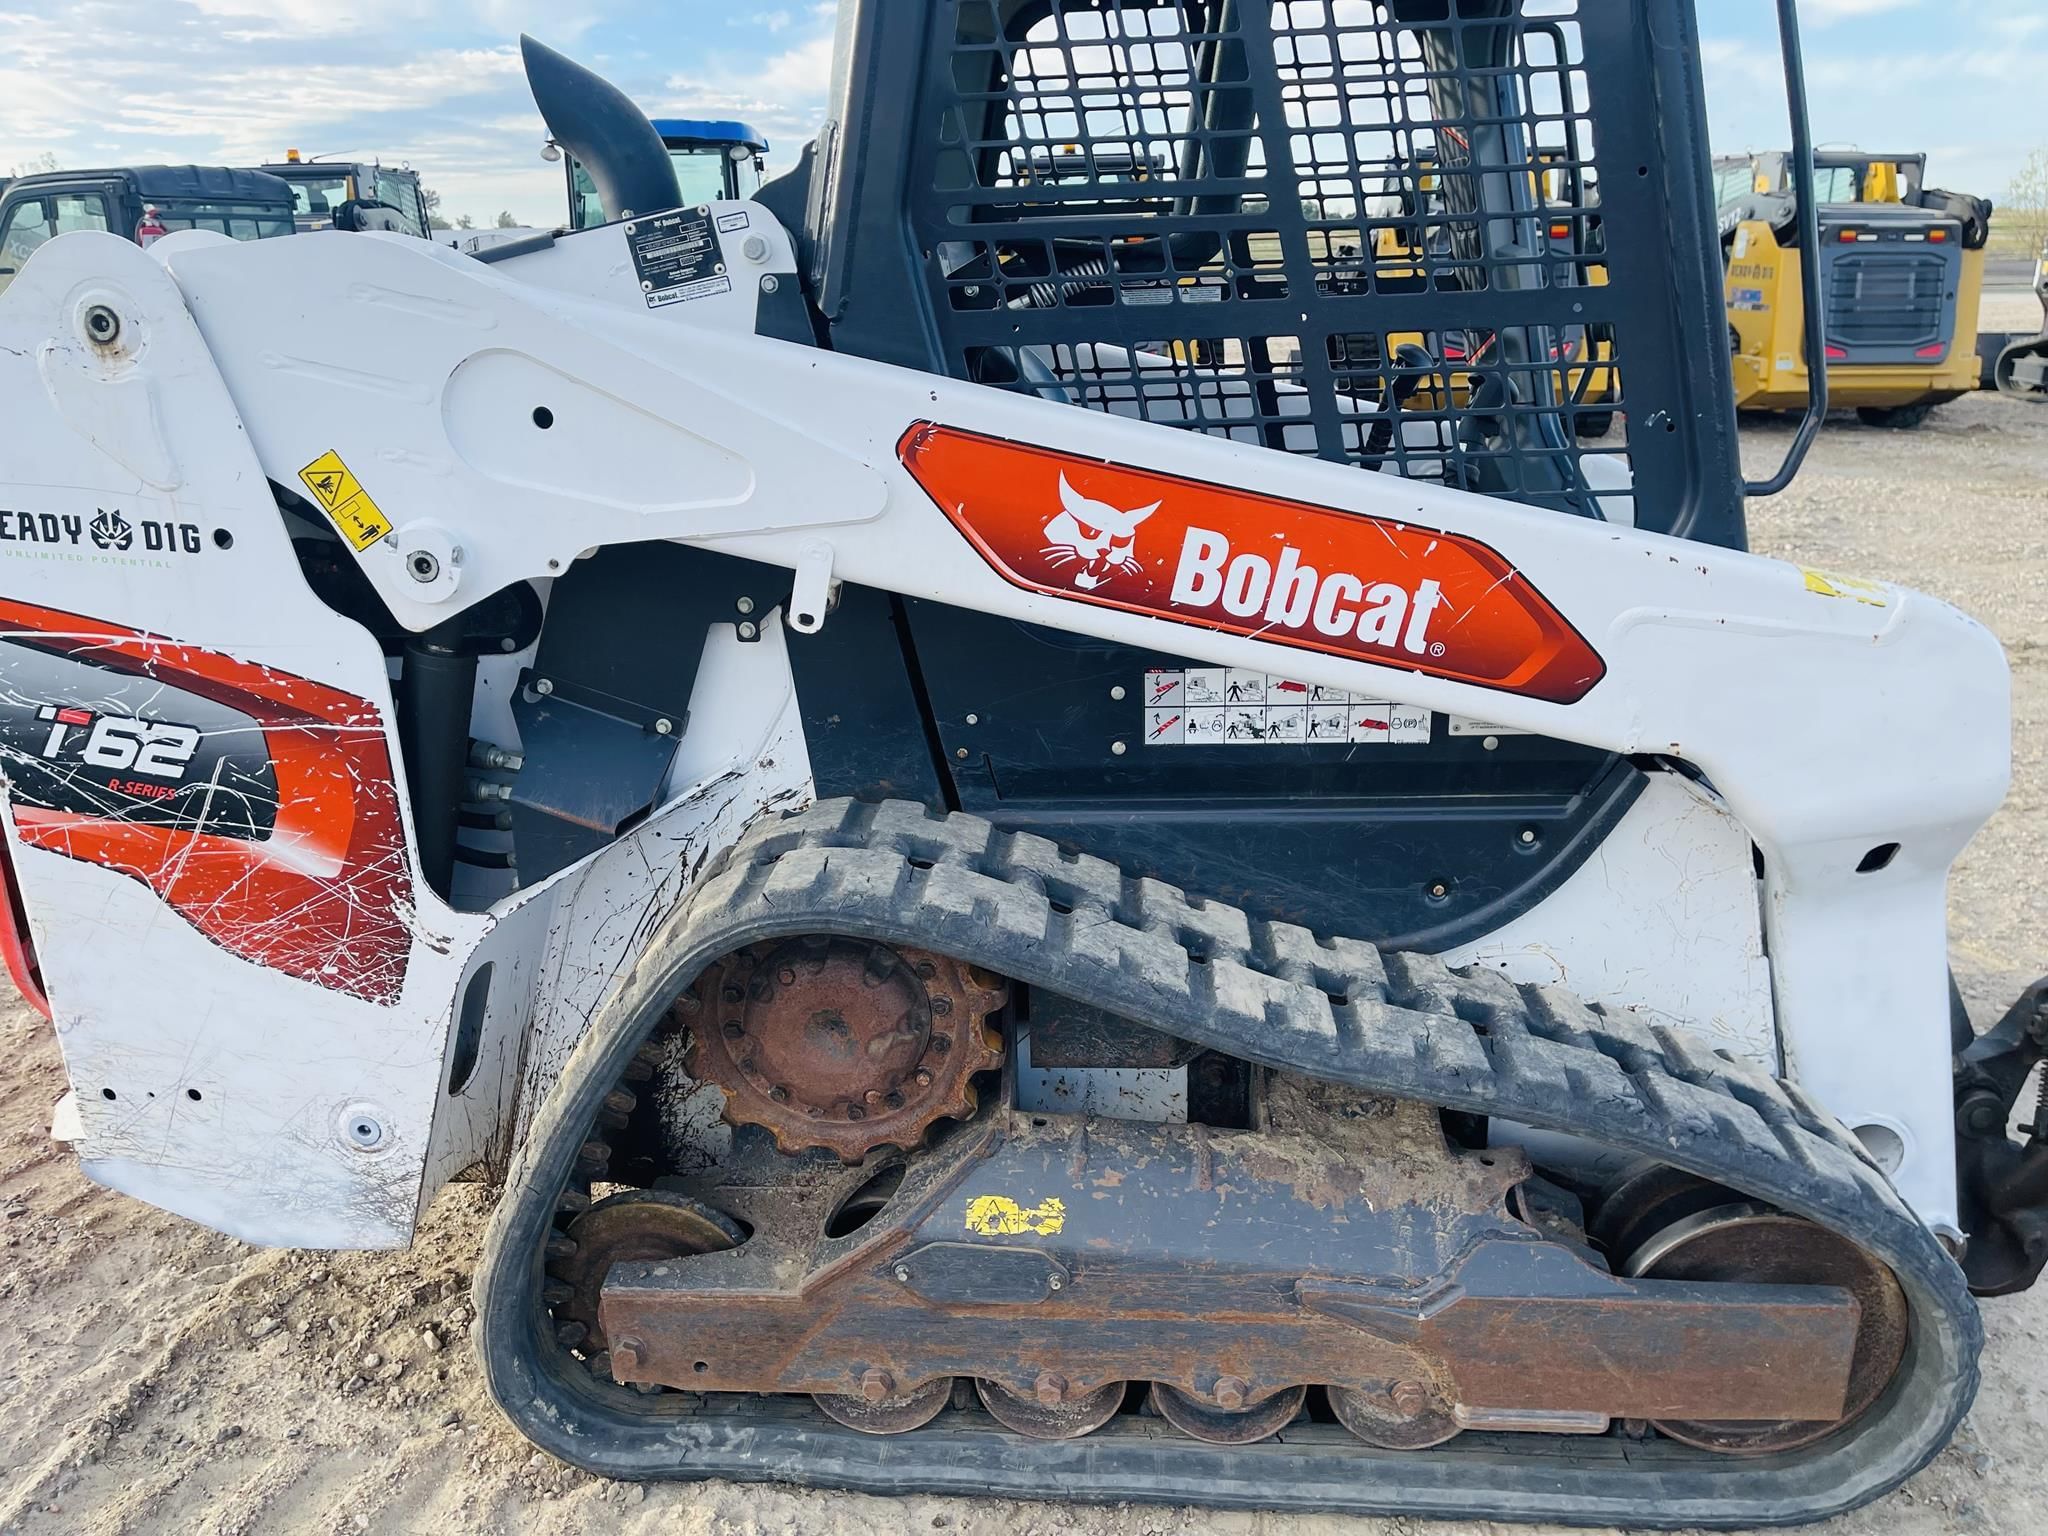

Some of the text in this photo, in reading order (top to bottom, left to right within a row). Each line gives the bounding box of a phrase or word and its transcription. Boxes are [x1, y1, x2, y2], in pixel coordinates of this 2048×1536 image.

[657, 292, 679, 302] Bobcat
[141, 520, 201, 554] DIG
[5, 549, 173, 569] UNLIMITED POTENTIAL
[1170, 526, 1441, 655] Bobcat
[38, 705, 201, 778] T62
[108, 778, 177, 801] R-SERIES
